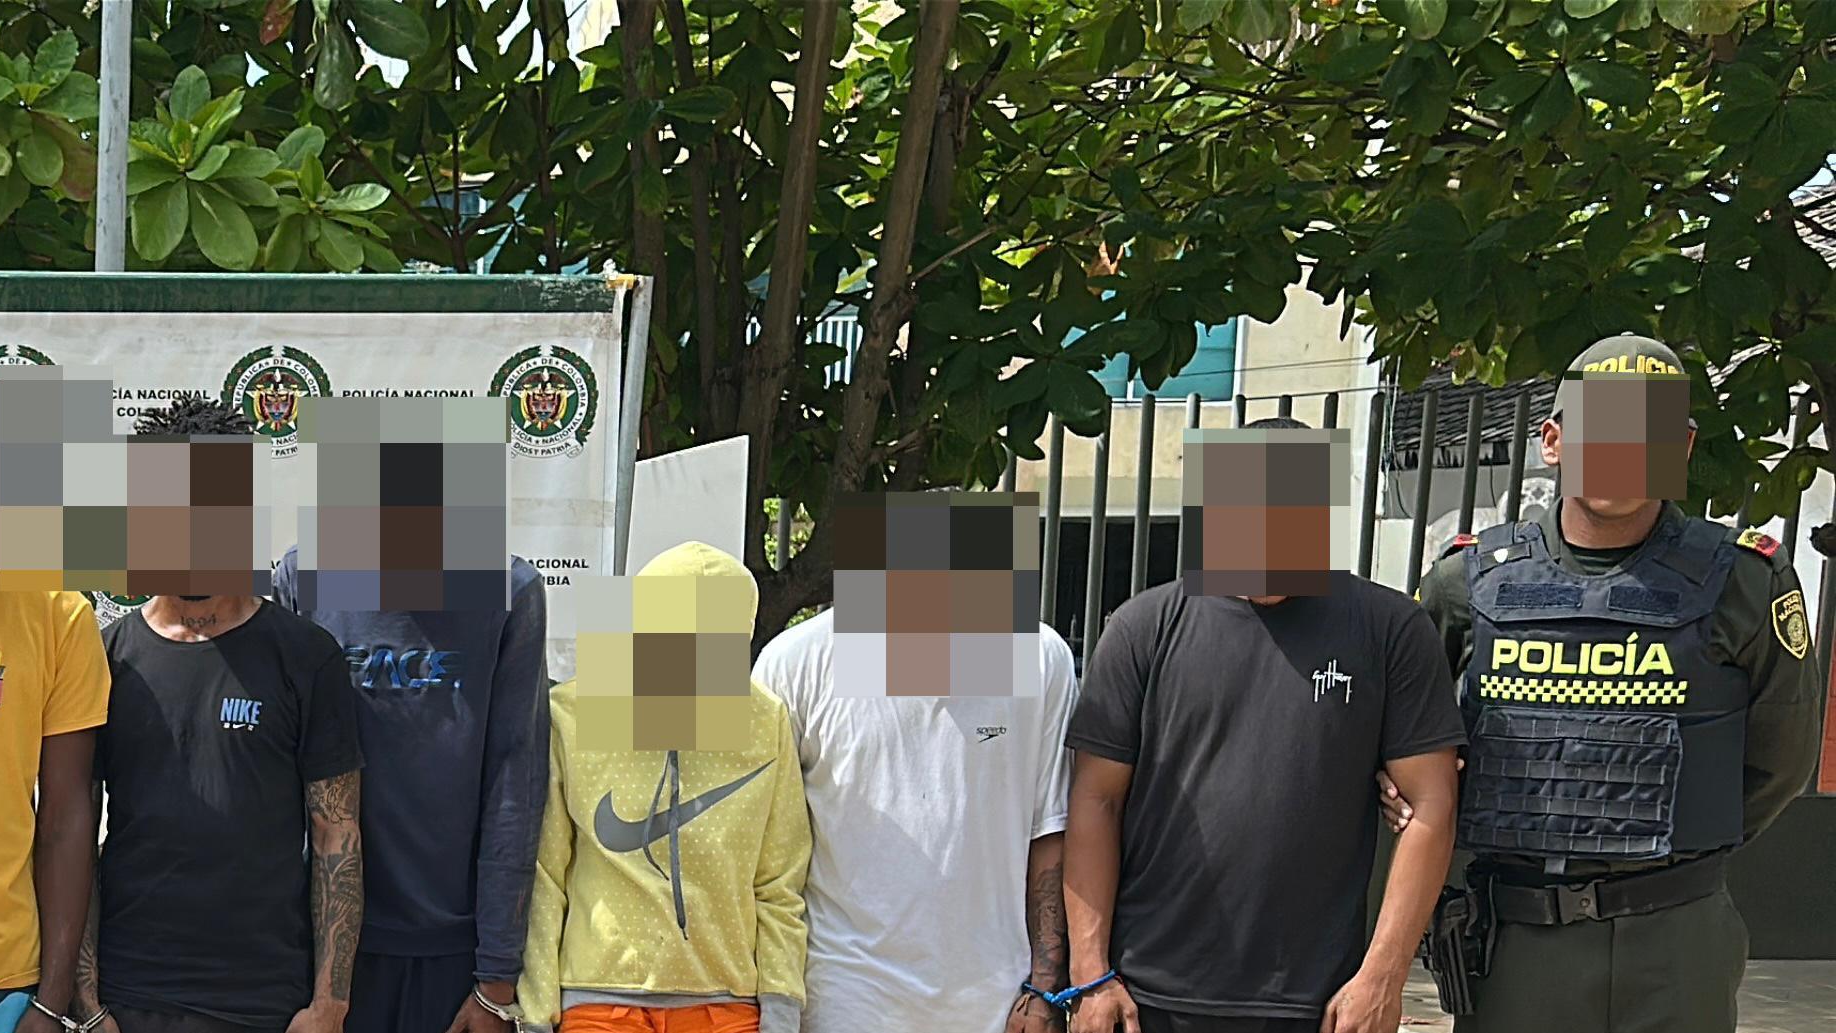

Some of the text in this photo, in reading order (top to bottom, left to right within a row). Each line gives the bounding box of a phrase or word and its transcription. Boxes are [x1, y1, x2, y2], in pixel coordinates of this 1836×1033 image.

[503, 362, 533, 397] PUBLICA
[1491, 631, 1675, 676] POLICÍA
[220, 697, 263, 725] NIKE
